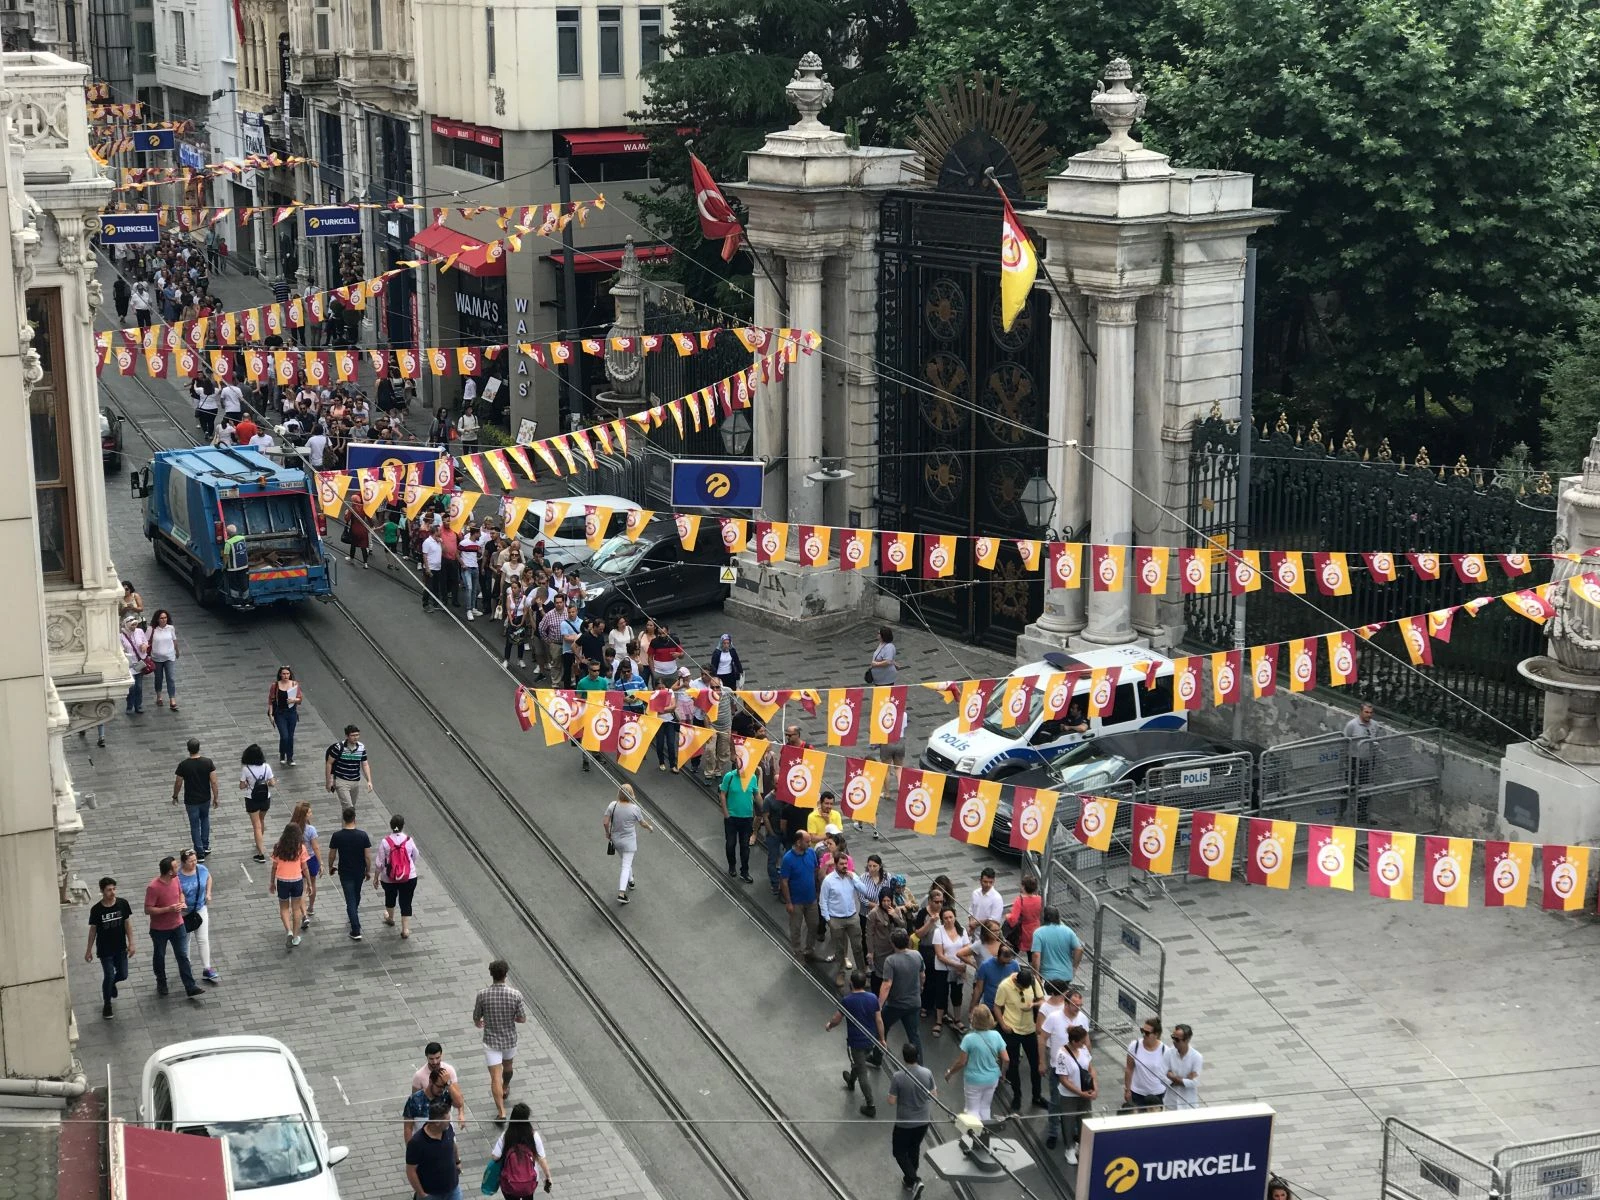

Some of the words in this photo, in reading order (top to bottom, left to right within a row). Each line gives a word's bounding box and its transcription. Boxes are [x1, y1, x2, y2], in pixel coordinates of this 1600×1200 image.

[116, 225, 154, 233] TURKCELL
[320, 217, 356, 226] TURKCELL
[455, 291, 499, 323] WAMA'S
[938, 733, 970, 751] POLİS
[1183, 771, 1208, 784] POLİS
[1142, 1152, 1256, 1182] TURKCELL
